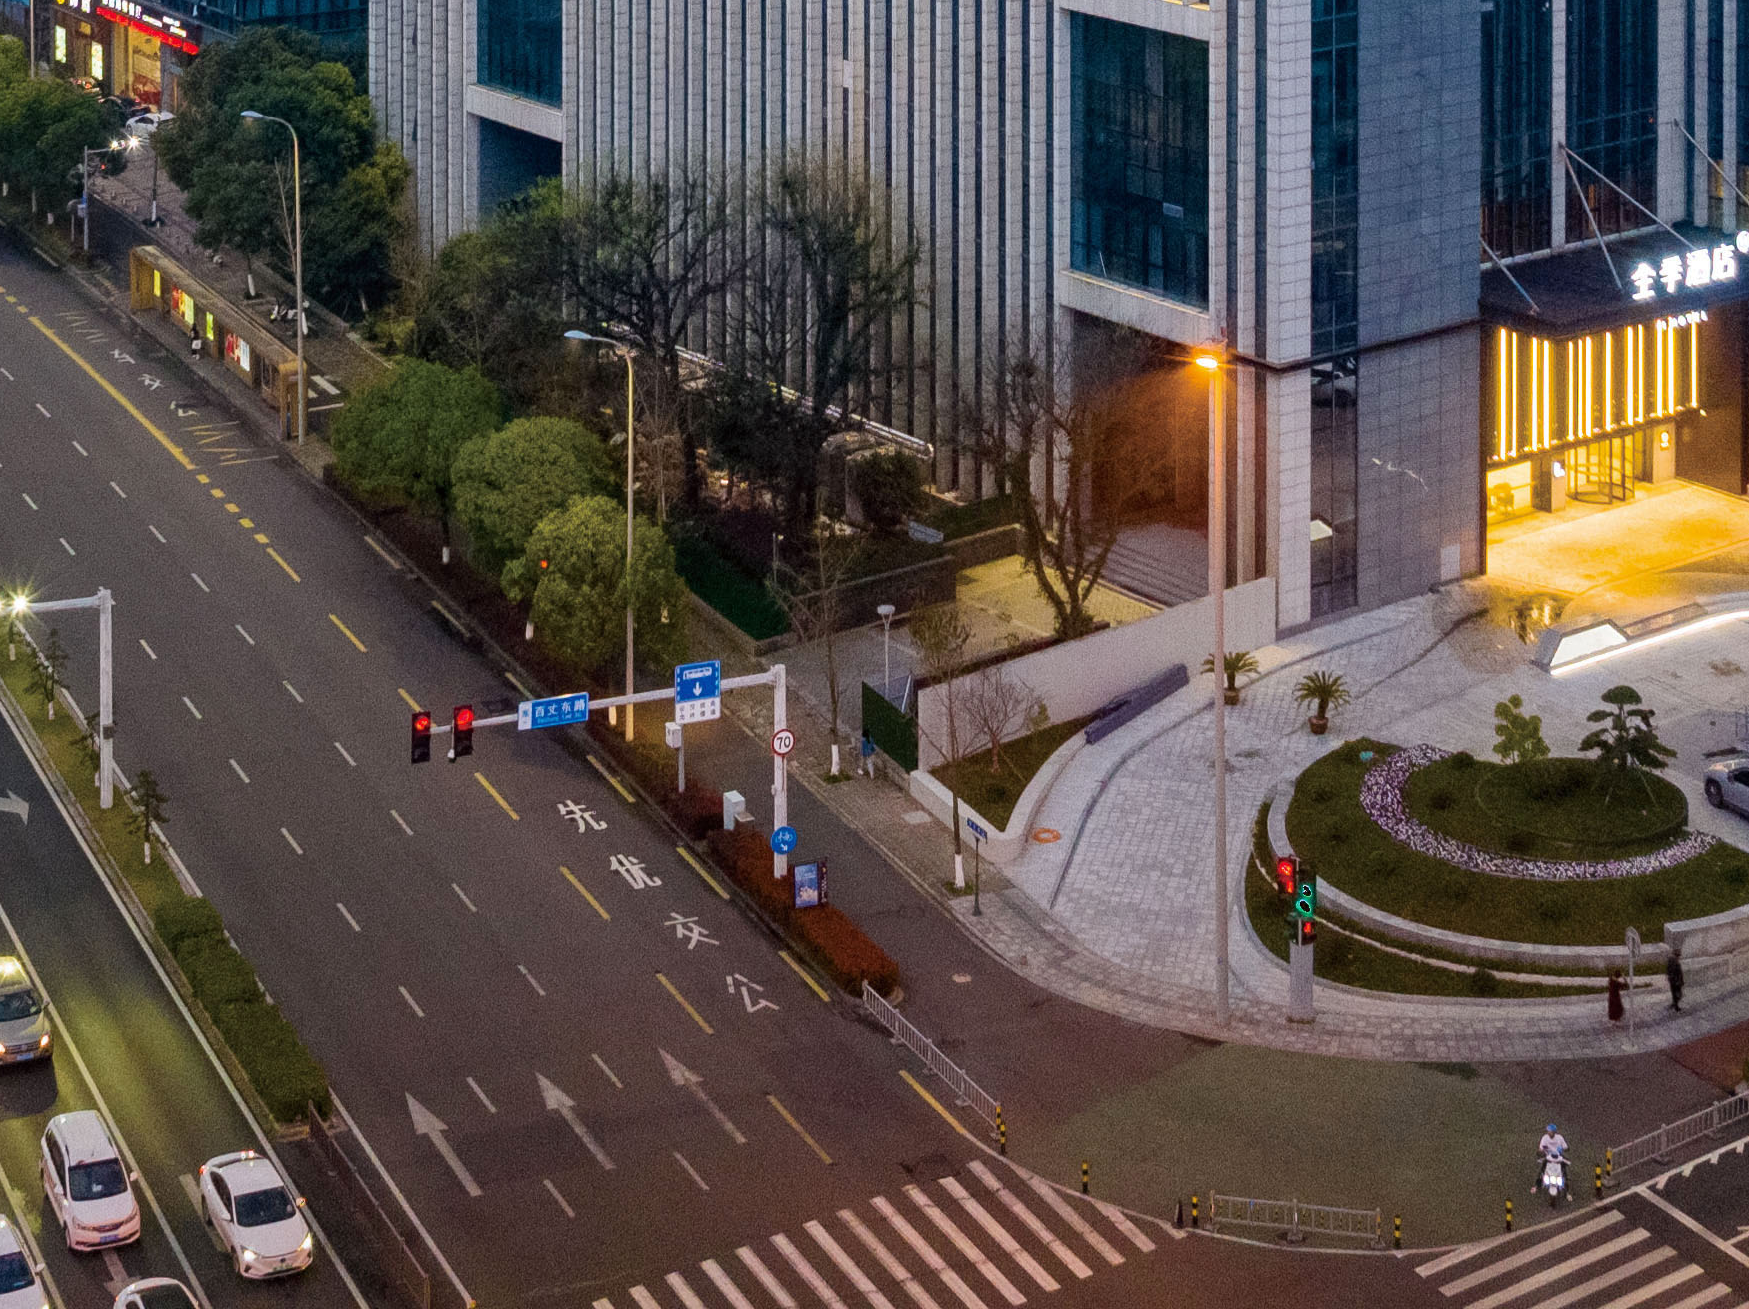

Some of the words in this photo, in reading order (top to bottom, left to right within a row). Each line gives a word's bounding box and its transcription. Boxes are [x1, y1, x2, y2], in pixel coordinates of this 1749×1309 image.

[1630, 242, 1736, 300] 全季酒店
[776, 735, 791, 750] 70
